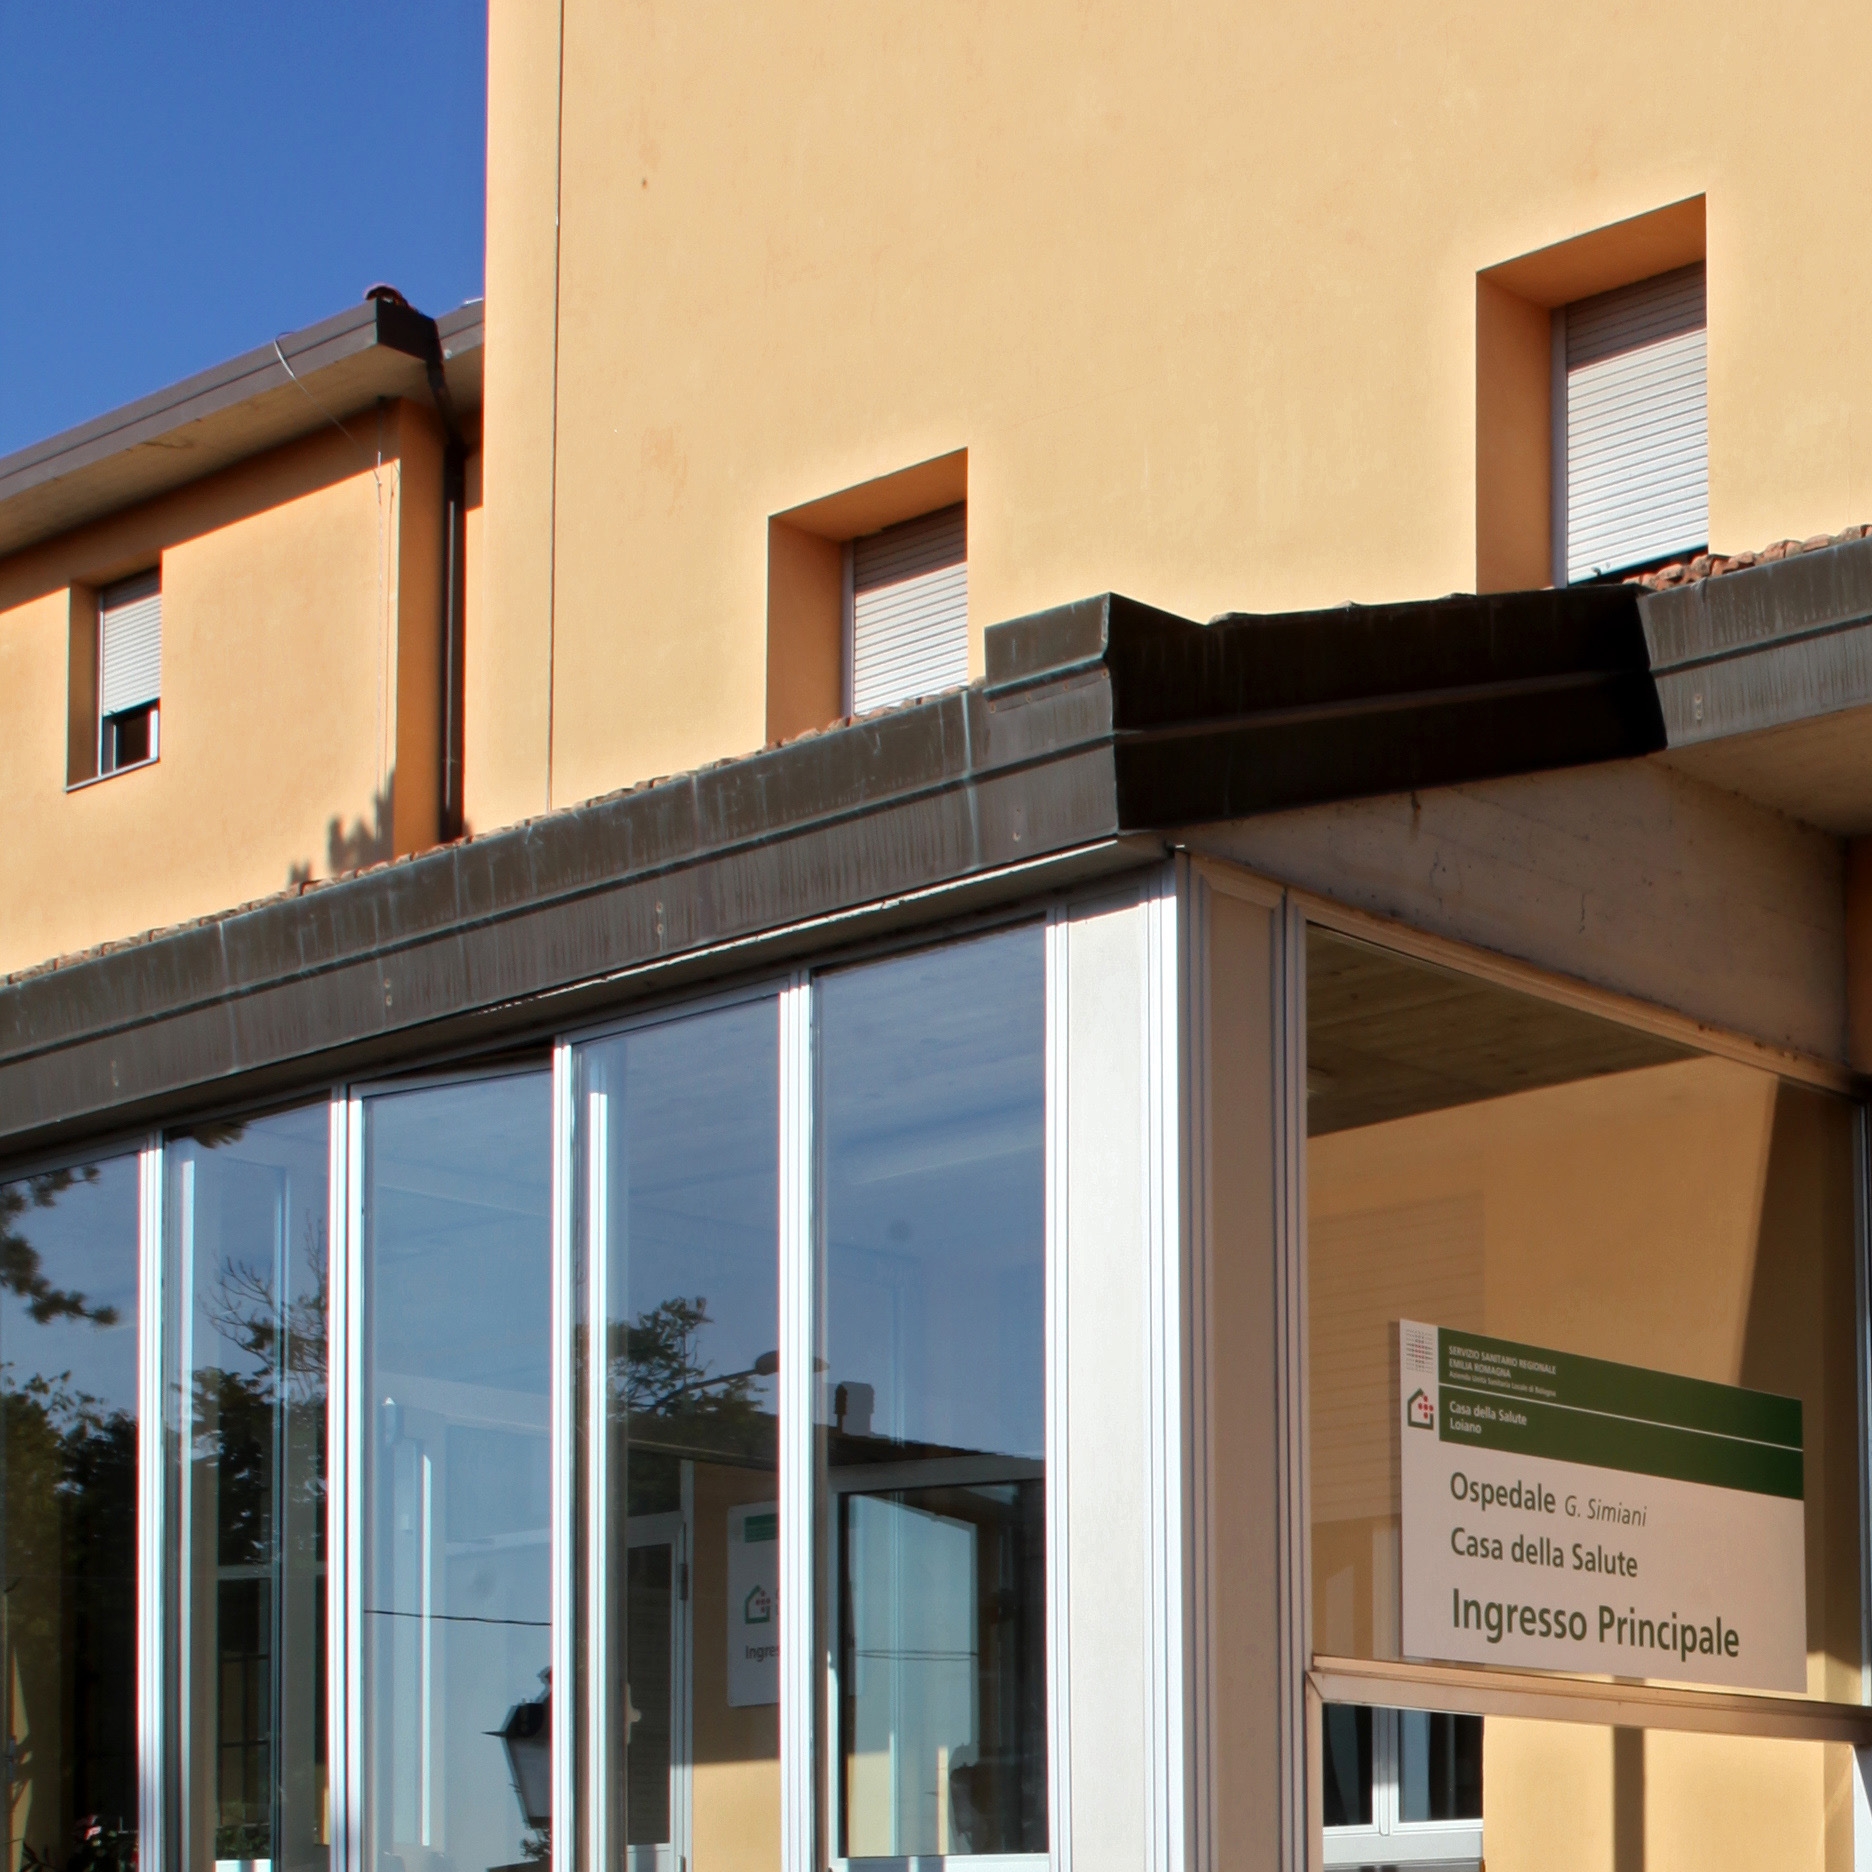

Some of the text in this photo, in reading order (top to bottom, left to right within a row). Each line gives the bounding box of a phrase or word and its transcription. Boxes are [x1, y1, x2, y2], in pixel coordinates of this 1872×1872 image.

[1449, 1346, 1556, 1375] SERVIZIO SANITARIO REGIONALE
[1449, 1358, 1511, 1378] EMILIA ROMAGNA
[1450, 1400, 1527, 1425] Casa della Salute
[1450, 1418, 1482, 1434] Loiano
[1450, 1472, 1647, 1526] Ospedale G. Simiani
[1451, 1527, 1637, 1577] Casa della Salute
[1454, 1588, 1739, 1662] Ingresso Principale
